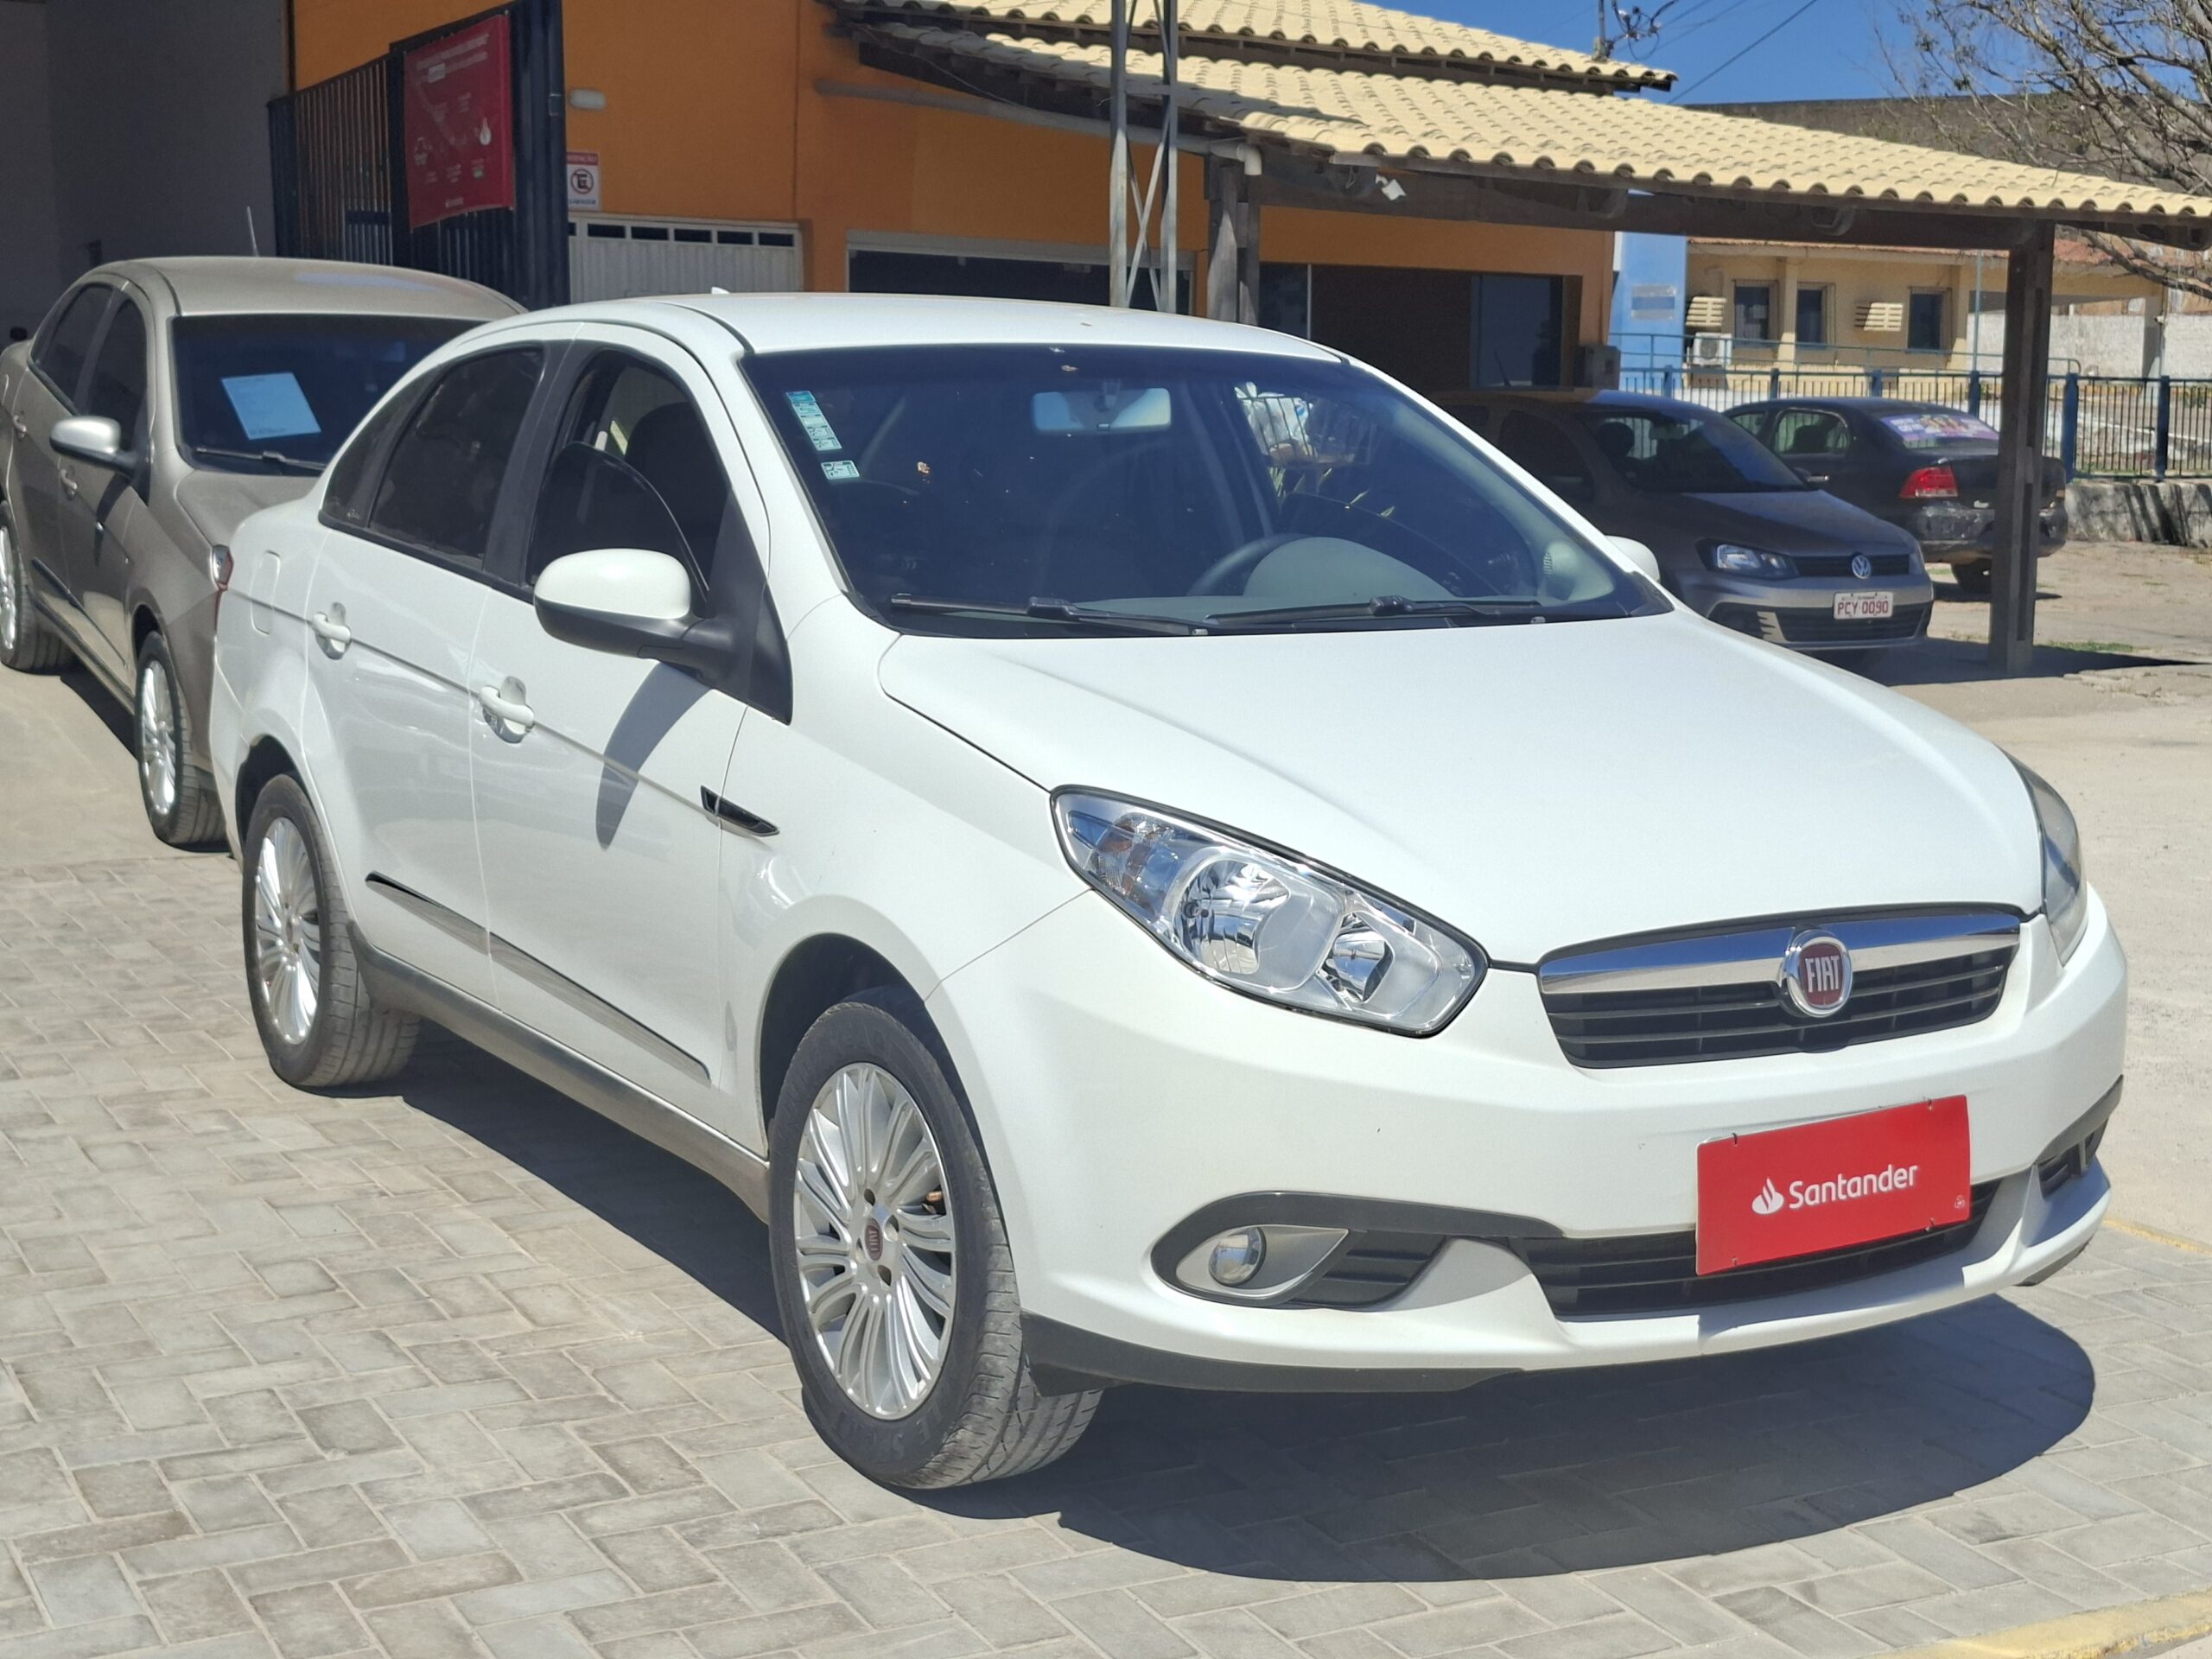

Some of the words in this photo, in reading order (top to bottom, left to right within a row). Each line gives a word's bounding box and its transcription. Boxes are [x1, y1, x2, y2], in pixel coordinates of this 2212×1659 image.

[1837, 601, 1858, 615] PCY
[1862, 600, 1889, 614] 0090
[1804, 955, 1840, 994] FIAT
[1789, 1164, 1918, 1209] Santander
